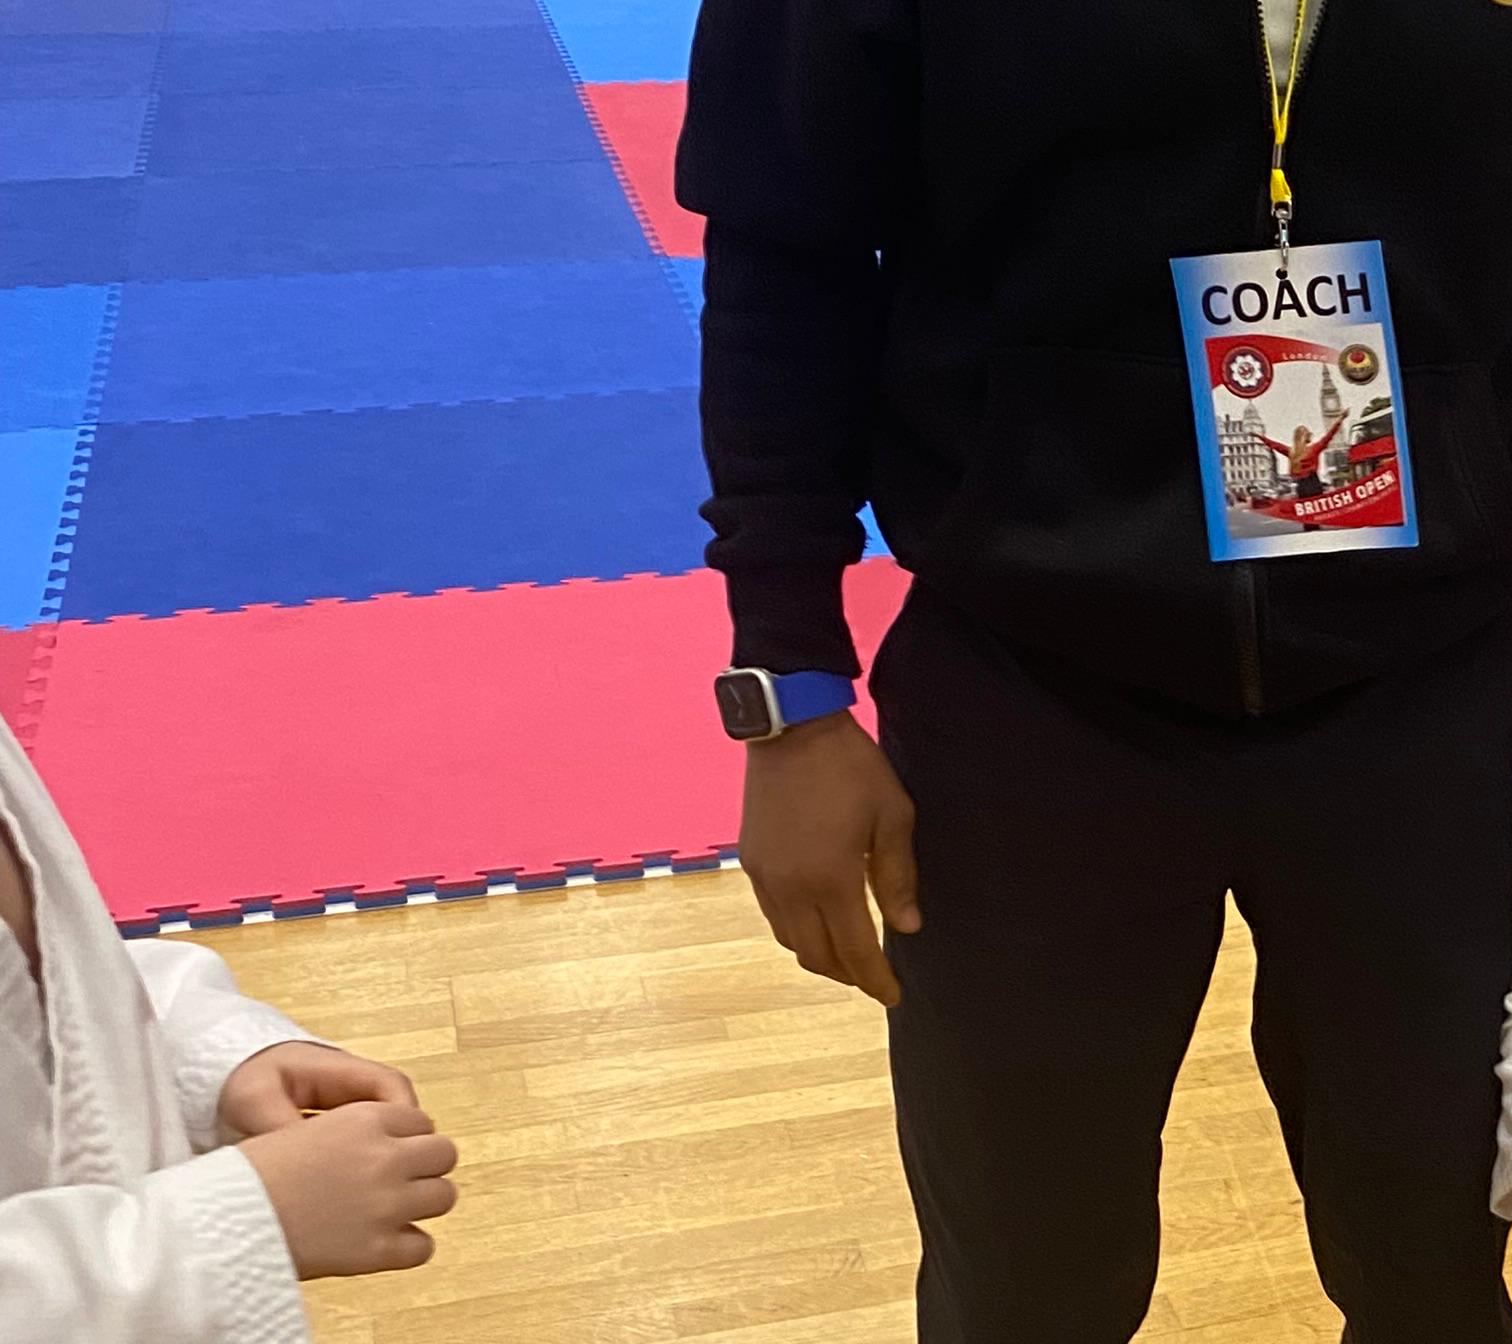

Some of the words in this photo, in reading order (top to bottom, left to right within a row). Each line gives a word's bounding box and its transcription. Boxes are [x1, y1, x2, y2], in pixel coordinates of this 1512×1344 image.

[1201, 271, 1373, 326] COACH
[1294, 490, 1354, 516] BRITISH
[1355, 470, 1396, 499] OPEN
